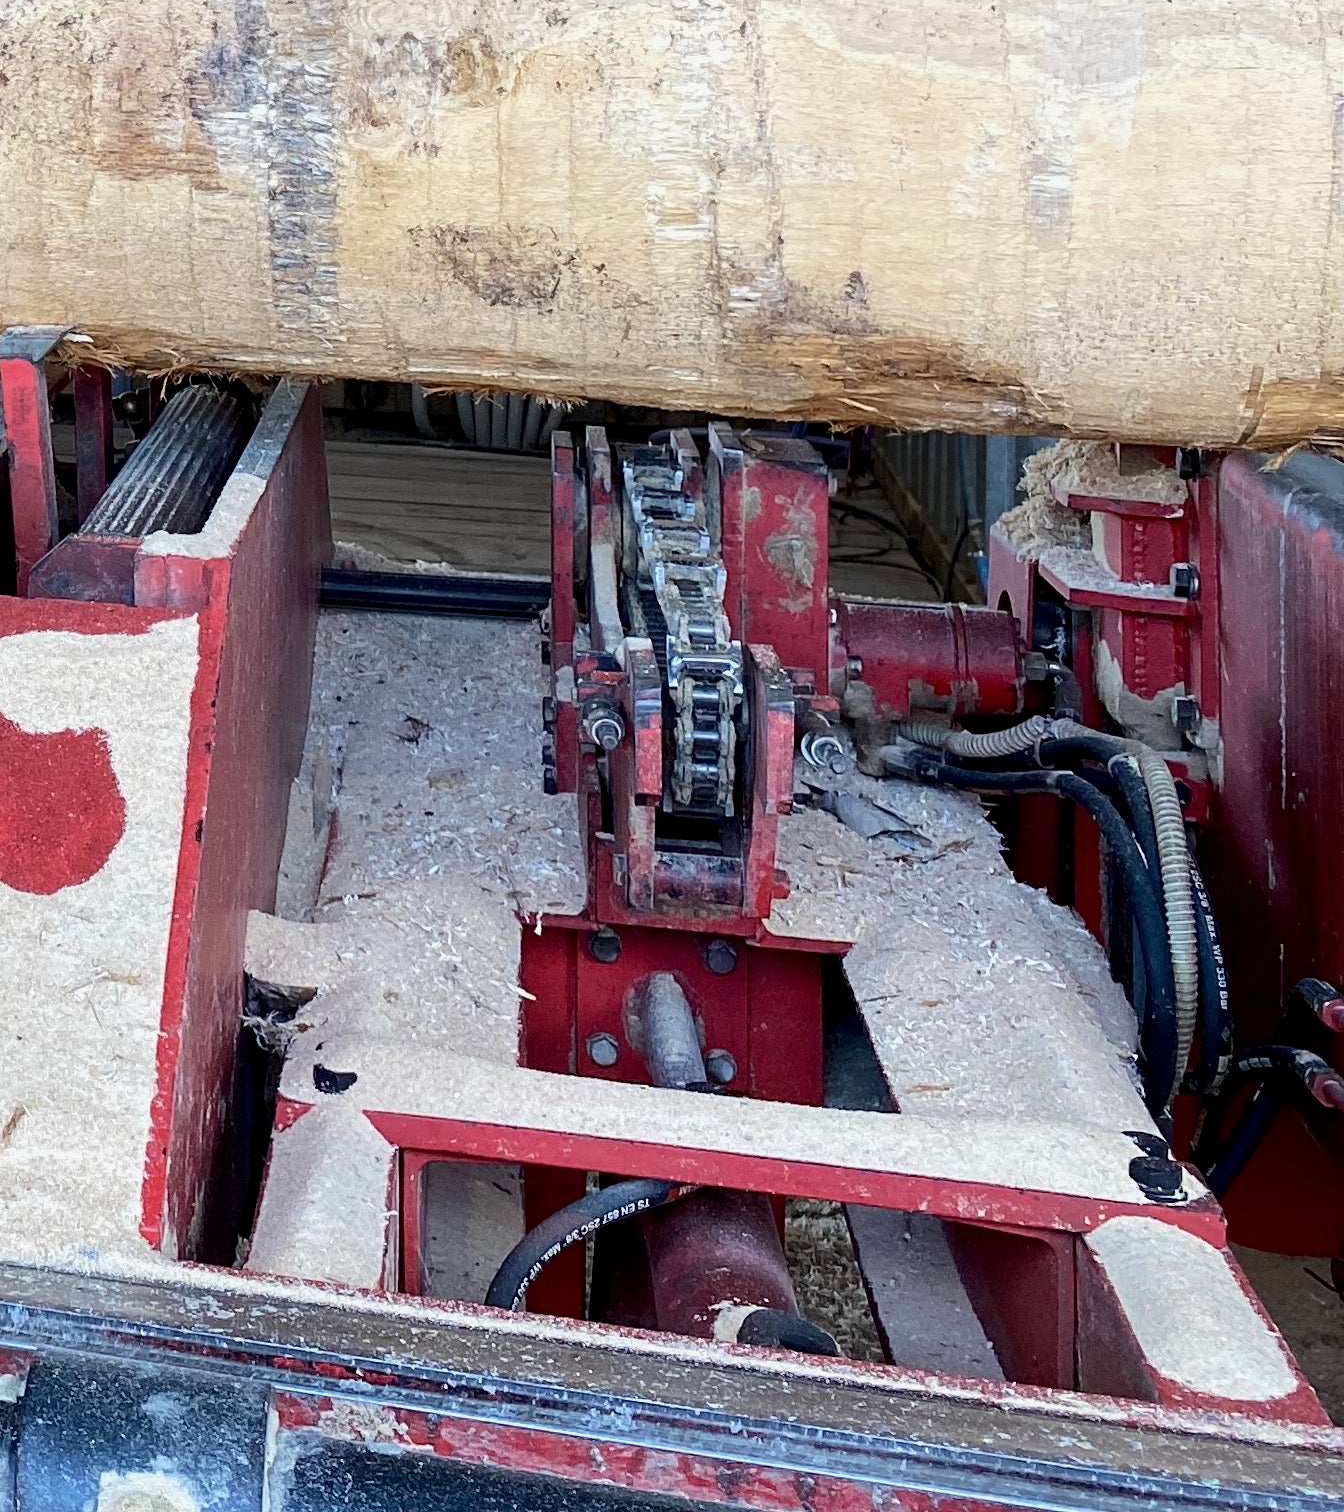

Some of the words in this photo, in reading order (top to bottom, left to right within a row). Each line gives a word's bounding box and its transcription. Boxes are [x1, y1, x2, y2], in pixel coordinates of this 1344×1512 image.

[1213, 944, 1223, 965] WP
[1216, 967, 1227, 988] 330
[1219, 990, 1229, 1010] Bar
[620, 1203, 636, 1217] EN
[637, 1197, 650, 1211] TS
[581, 1217, 601, 1236] 2SC
[602, 1210, 620, 1225] 857
